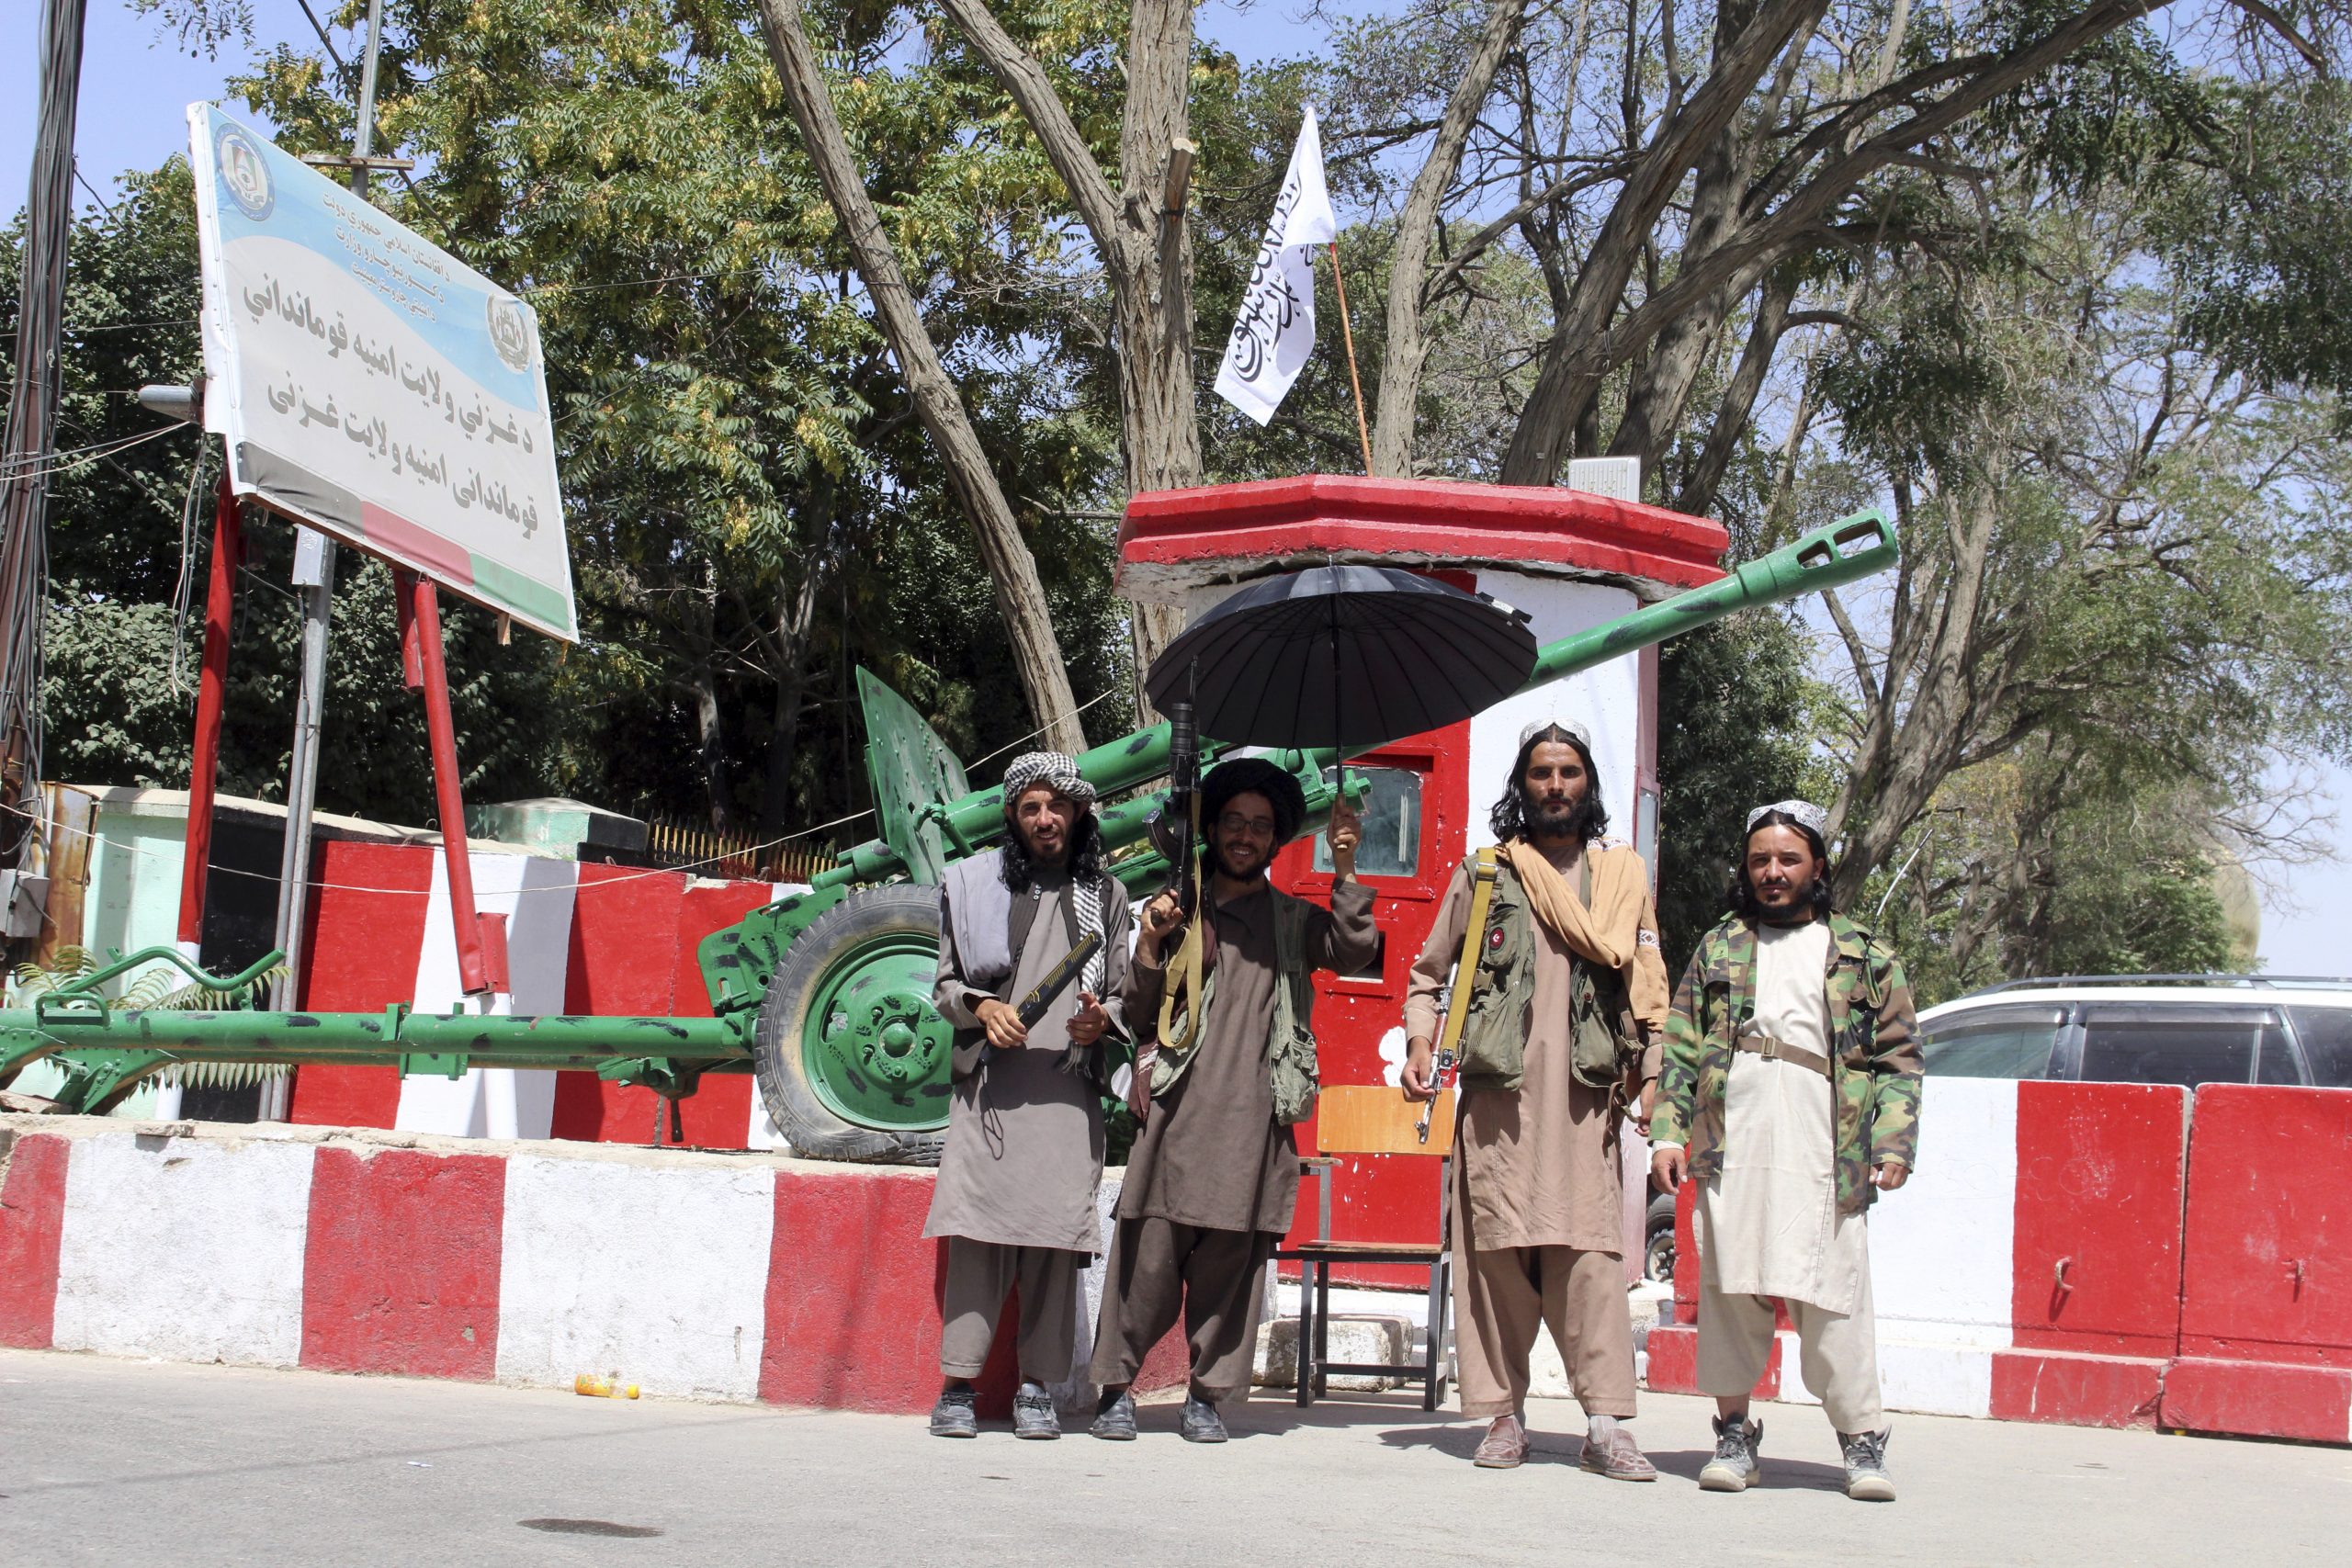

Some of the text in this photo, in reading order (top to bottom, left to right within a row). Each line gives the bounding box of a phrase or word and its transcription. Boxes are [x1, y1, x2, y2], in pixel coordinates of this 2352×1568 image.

[323, 193, 345, 217] دولت
[335, 227, 362, 256] وزارت
[348, 212, 381, 242] جمهوري
[384, 237, 411, 254] اسلامي
[364, 247, 390, 274] چارو
[413, 249, 444, 276] افغانستان
[243, 272, 347, 358] قومانداني
[353, 333, 397, 380] امنیه
[401, 362, 455, 423] ولایت
[267, 370, 538, 540] قوماندانی امنیه ولایت غزنی
[522, 427, 534, 454] د
